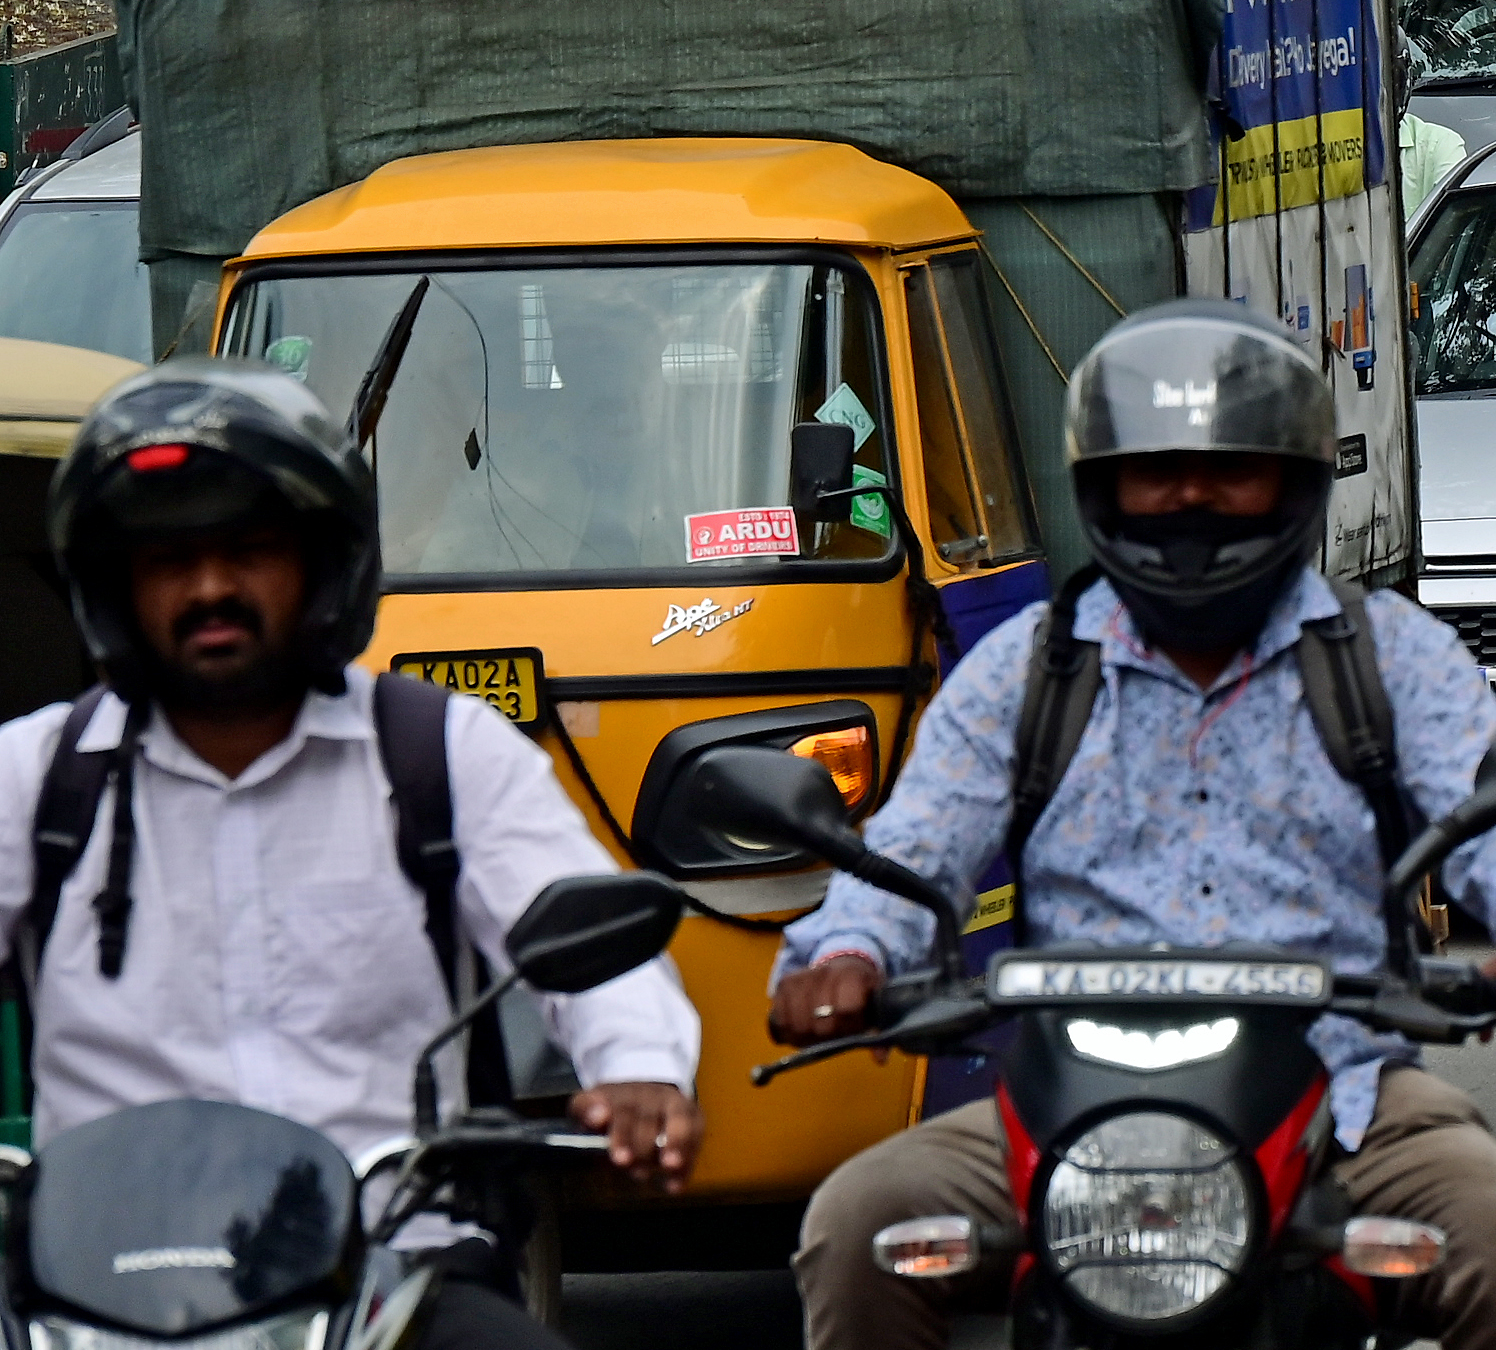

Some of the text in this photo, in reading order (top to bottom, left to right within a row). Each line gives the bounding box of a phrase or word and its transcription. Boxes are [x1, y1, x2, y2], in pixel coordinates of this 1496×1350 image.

[719, 521, 791, 542] ARDU
[695, 545, 729, 557] UNITY
[731, 543, 746, 553] OF
[423, 660, 521, 690] KA02A
